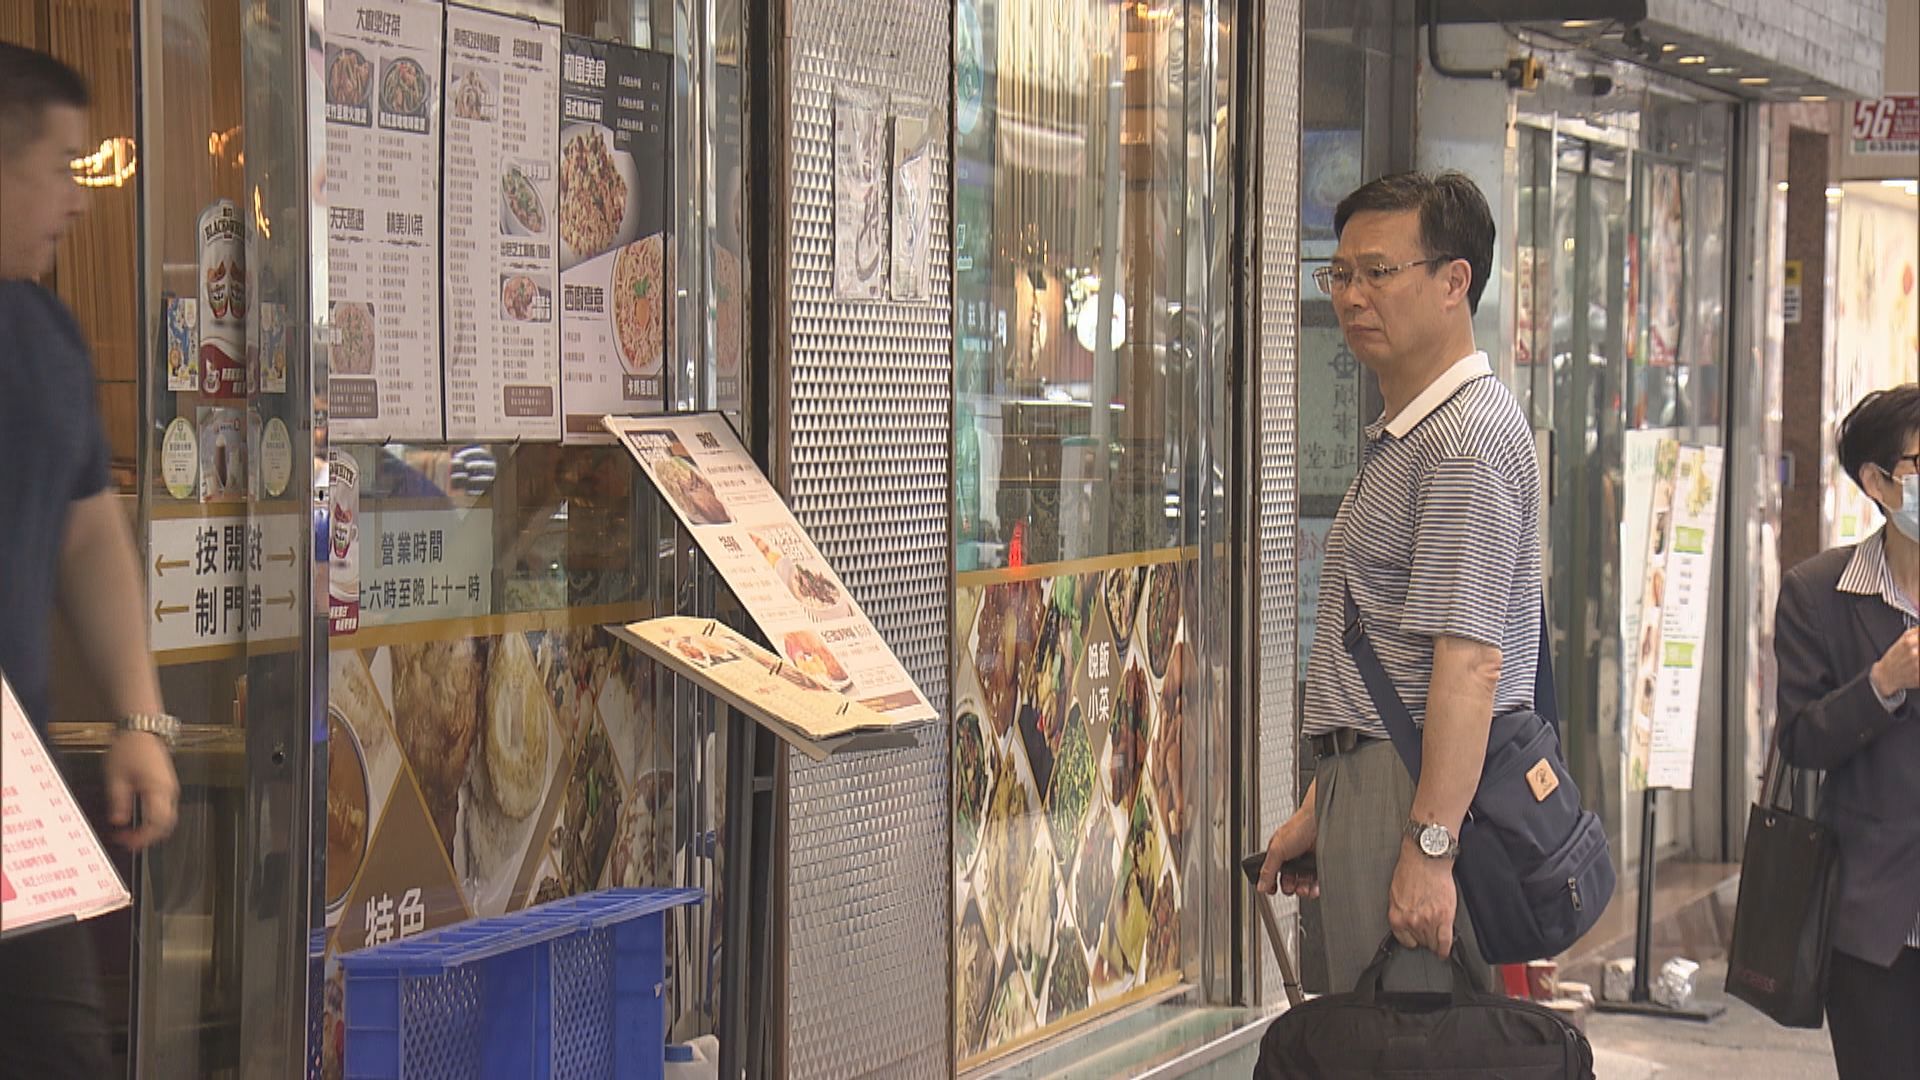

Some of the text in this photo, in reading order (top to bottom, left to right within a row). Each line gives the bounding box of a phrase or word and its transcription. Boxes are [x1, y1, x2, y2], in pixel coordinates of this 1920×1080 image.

[563, 53, 607, 88] 和風美食
[1852, 98, 1896, 139] 5G
[381, 530, 443, 566] 營業時間
[1088, 641, 1109, 680] 晚飯
[1088, 685, 1109, 725] 小菜
[365, 888, 425, 948] 特色
